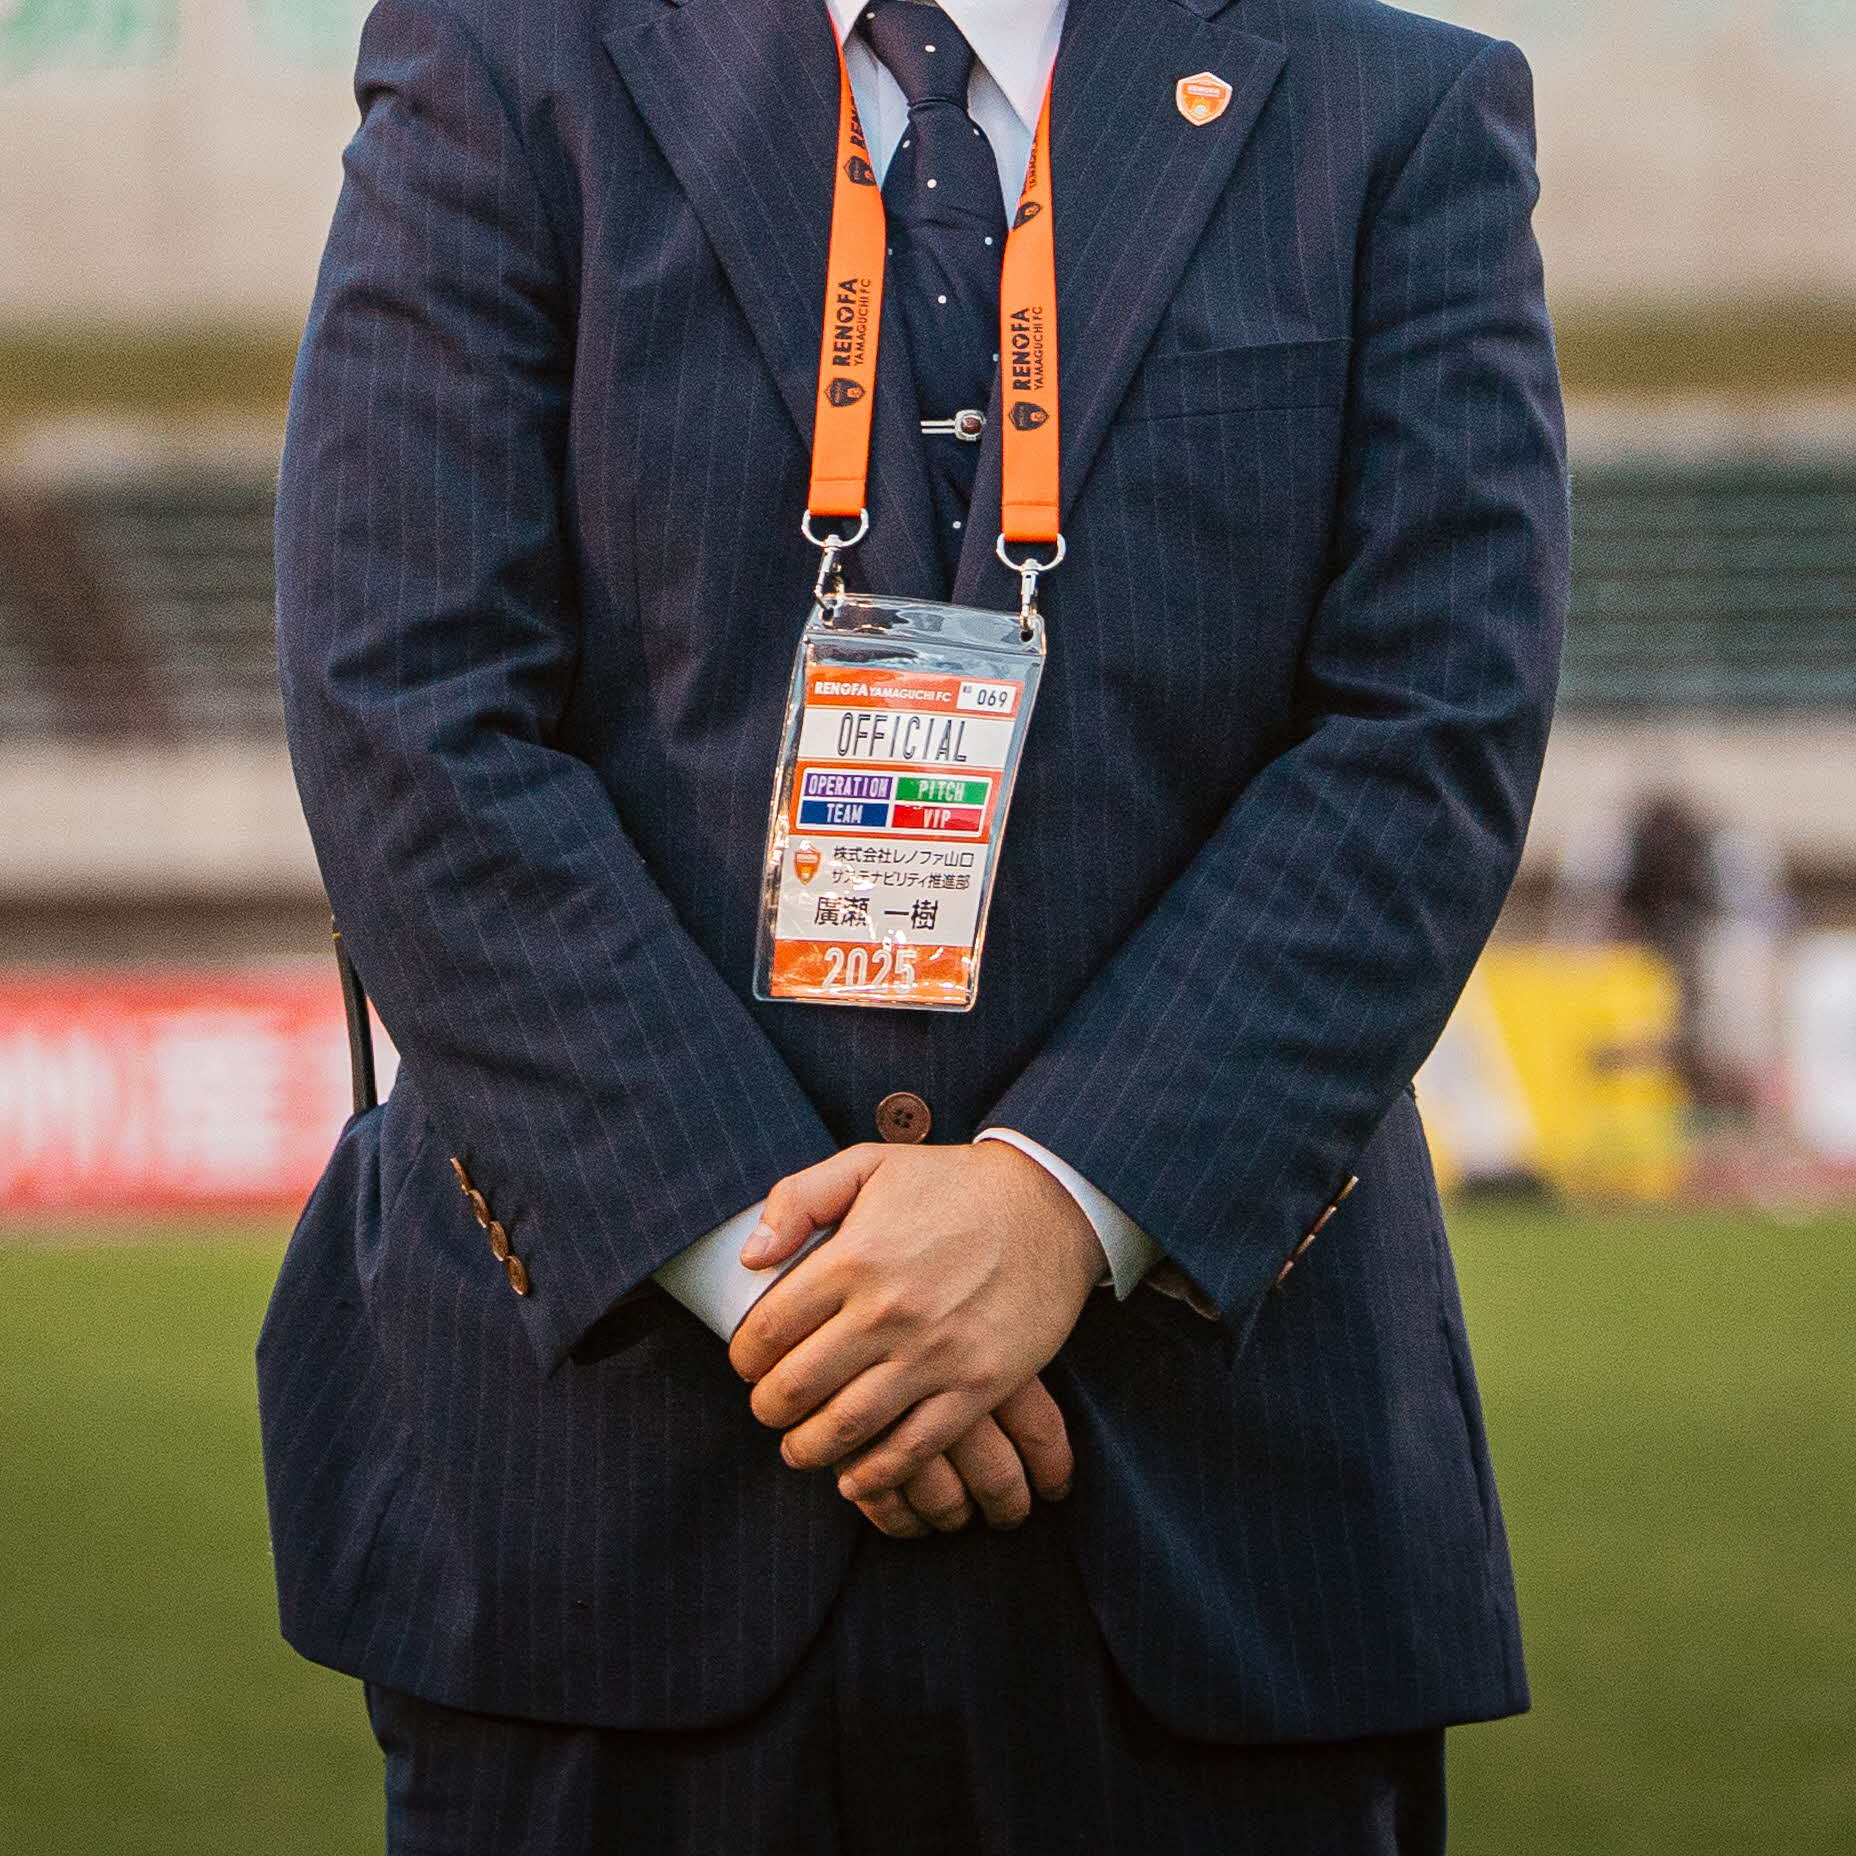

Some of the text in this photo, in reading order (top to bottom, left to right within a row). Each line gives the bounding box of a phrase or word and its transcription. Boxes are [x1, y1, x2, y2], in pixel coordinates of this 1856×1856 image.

[832, 278, 858, 366] RENOFA
[854, 294, 869, 366] YAMAGUCHI
[1010, 308, 1031, 390] RENOFA
[1033, 324, 1044, 390] YAMAGUCHI
[815, 681, 952, 702] RENOFA YAMAGUCHI FC
[977, 688, 1008, 707] 069
[837, 712, 967, 762] OFFICIAL
[808, 775, 889, 798] OPERATION
[918, 780, 965, 801] PITCH
[826, 803, 863, 824] TEAM
[923, 808, 952, 829] VIP
[833, 846, 975, 868] 株式会社レノファ山口
[822, 947, 917, 994] 2025
